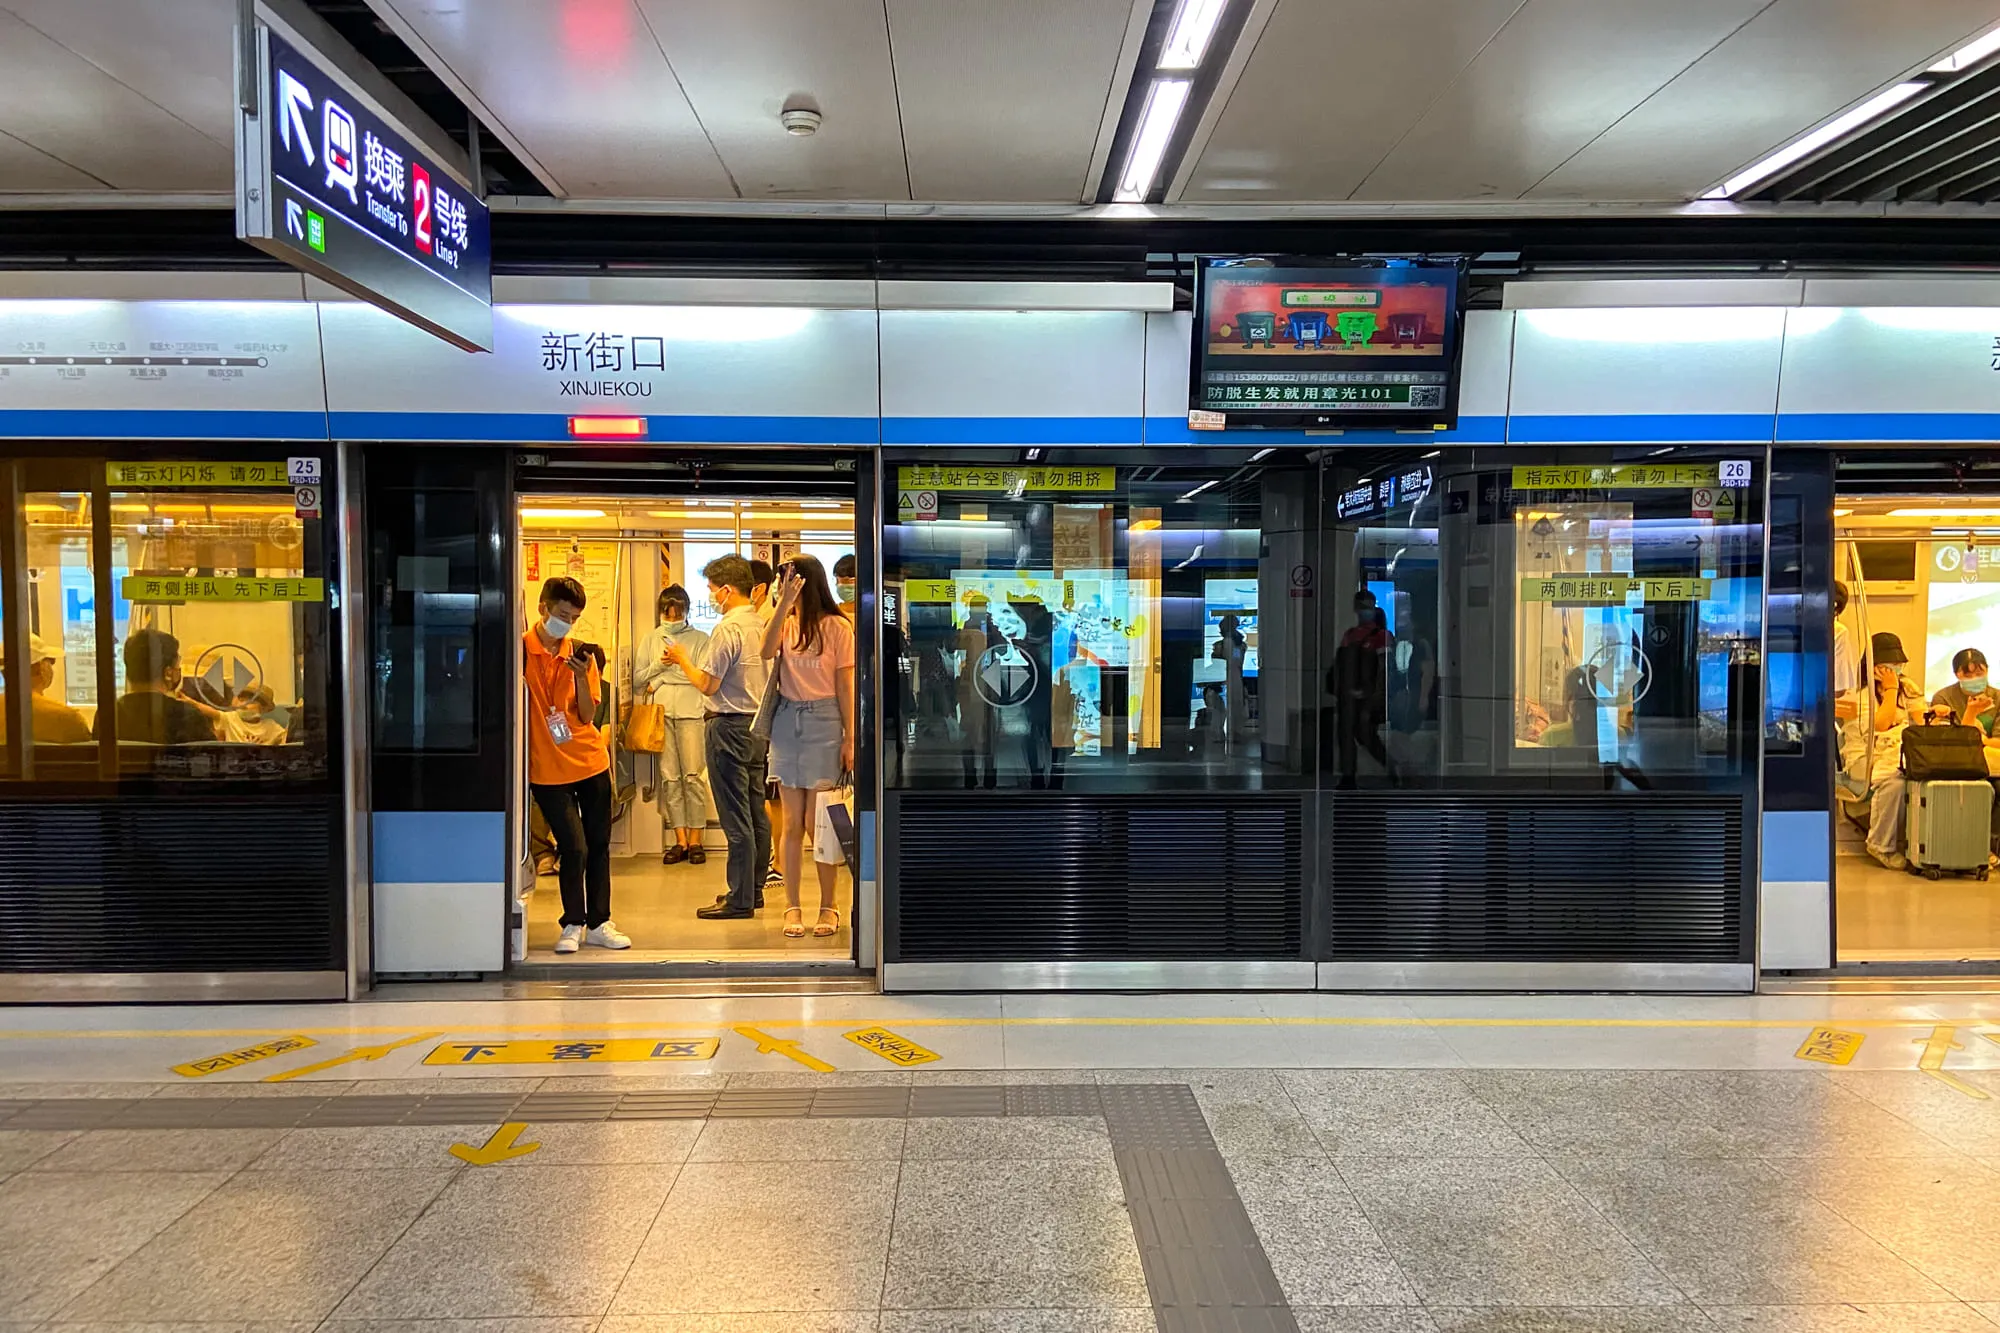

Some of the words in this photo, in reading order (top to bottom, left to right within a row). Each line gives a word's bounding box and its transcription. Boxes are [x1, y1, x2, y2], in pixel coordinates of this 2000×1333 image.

[365, 131, 405, 204] 换乘
[415, 179, 430, 244] 2
[434, 187, 468, 250] 号线
[366, 191, 396, 229] Transfer
[397, 212, 408, 236] To
[435, 238, 453, 265] Line
[454, 250, 459, 269] 2
[541, 331, 665, 372] 新街口
[560, 380, 652, 397] XINJIEKOU
[1207, 386, 1392, 400] 防脱生发就用章光101
[121, 466, 216, 482] 指示灯闪烁
[296, 460, 313, 474] 25
[1727, 463, 1744, 477] 26
[910, 471, 1017, 487] 注意站台空隙
[1031, 471, 1102, 487] 请勿拥挤
[1526, 468, 1618, 485] 指示灯闪烁
[146, 581, 219, 597] 两侧排队
[234, 581, 309, 597] 先下后上
[1541, 580, 1616, 597] 两侧排队
[1627, 580, 1702, 597] 先下后上
[448, 1042, 705, 1062] 下客区
[856, 1032, 930, 1062] 候车区
